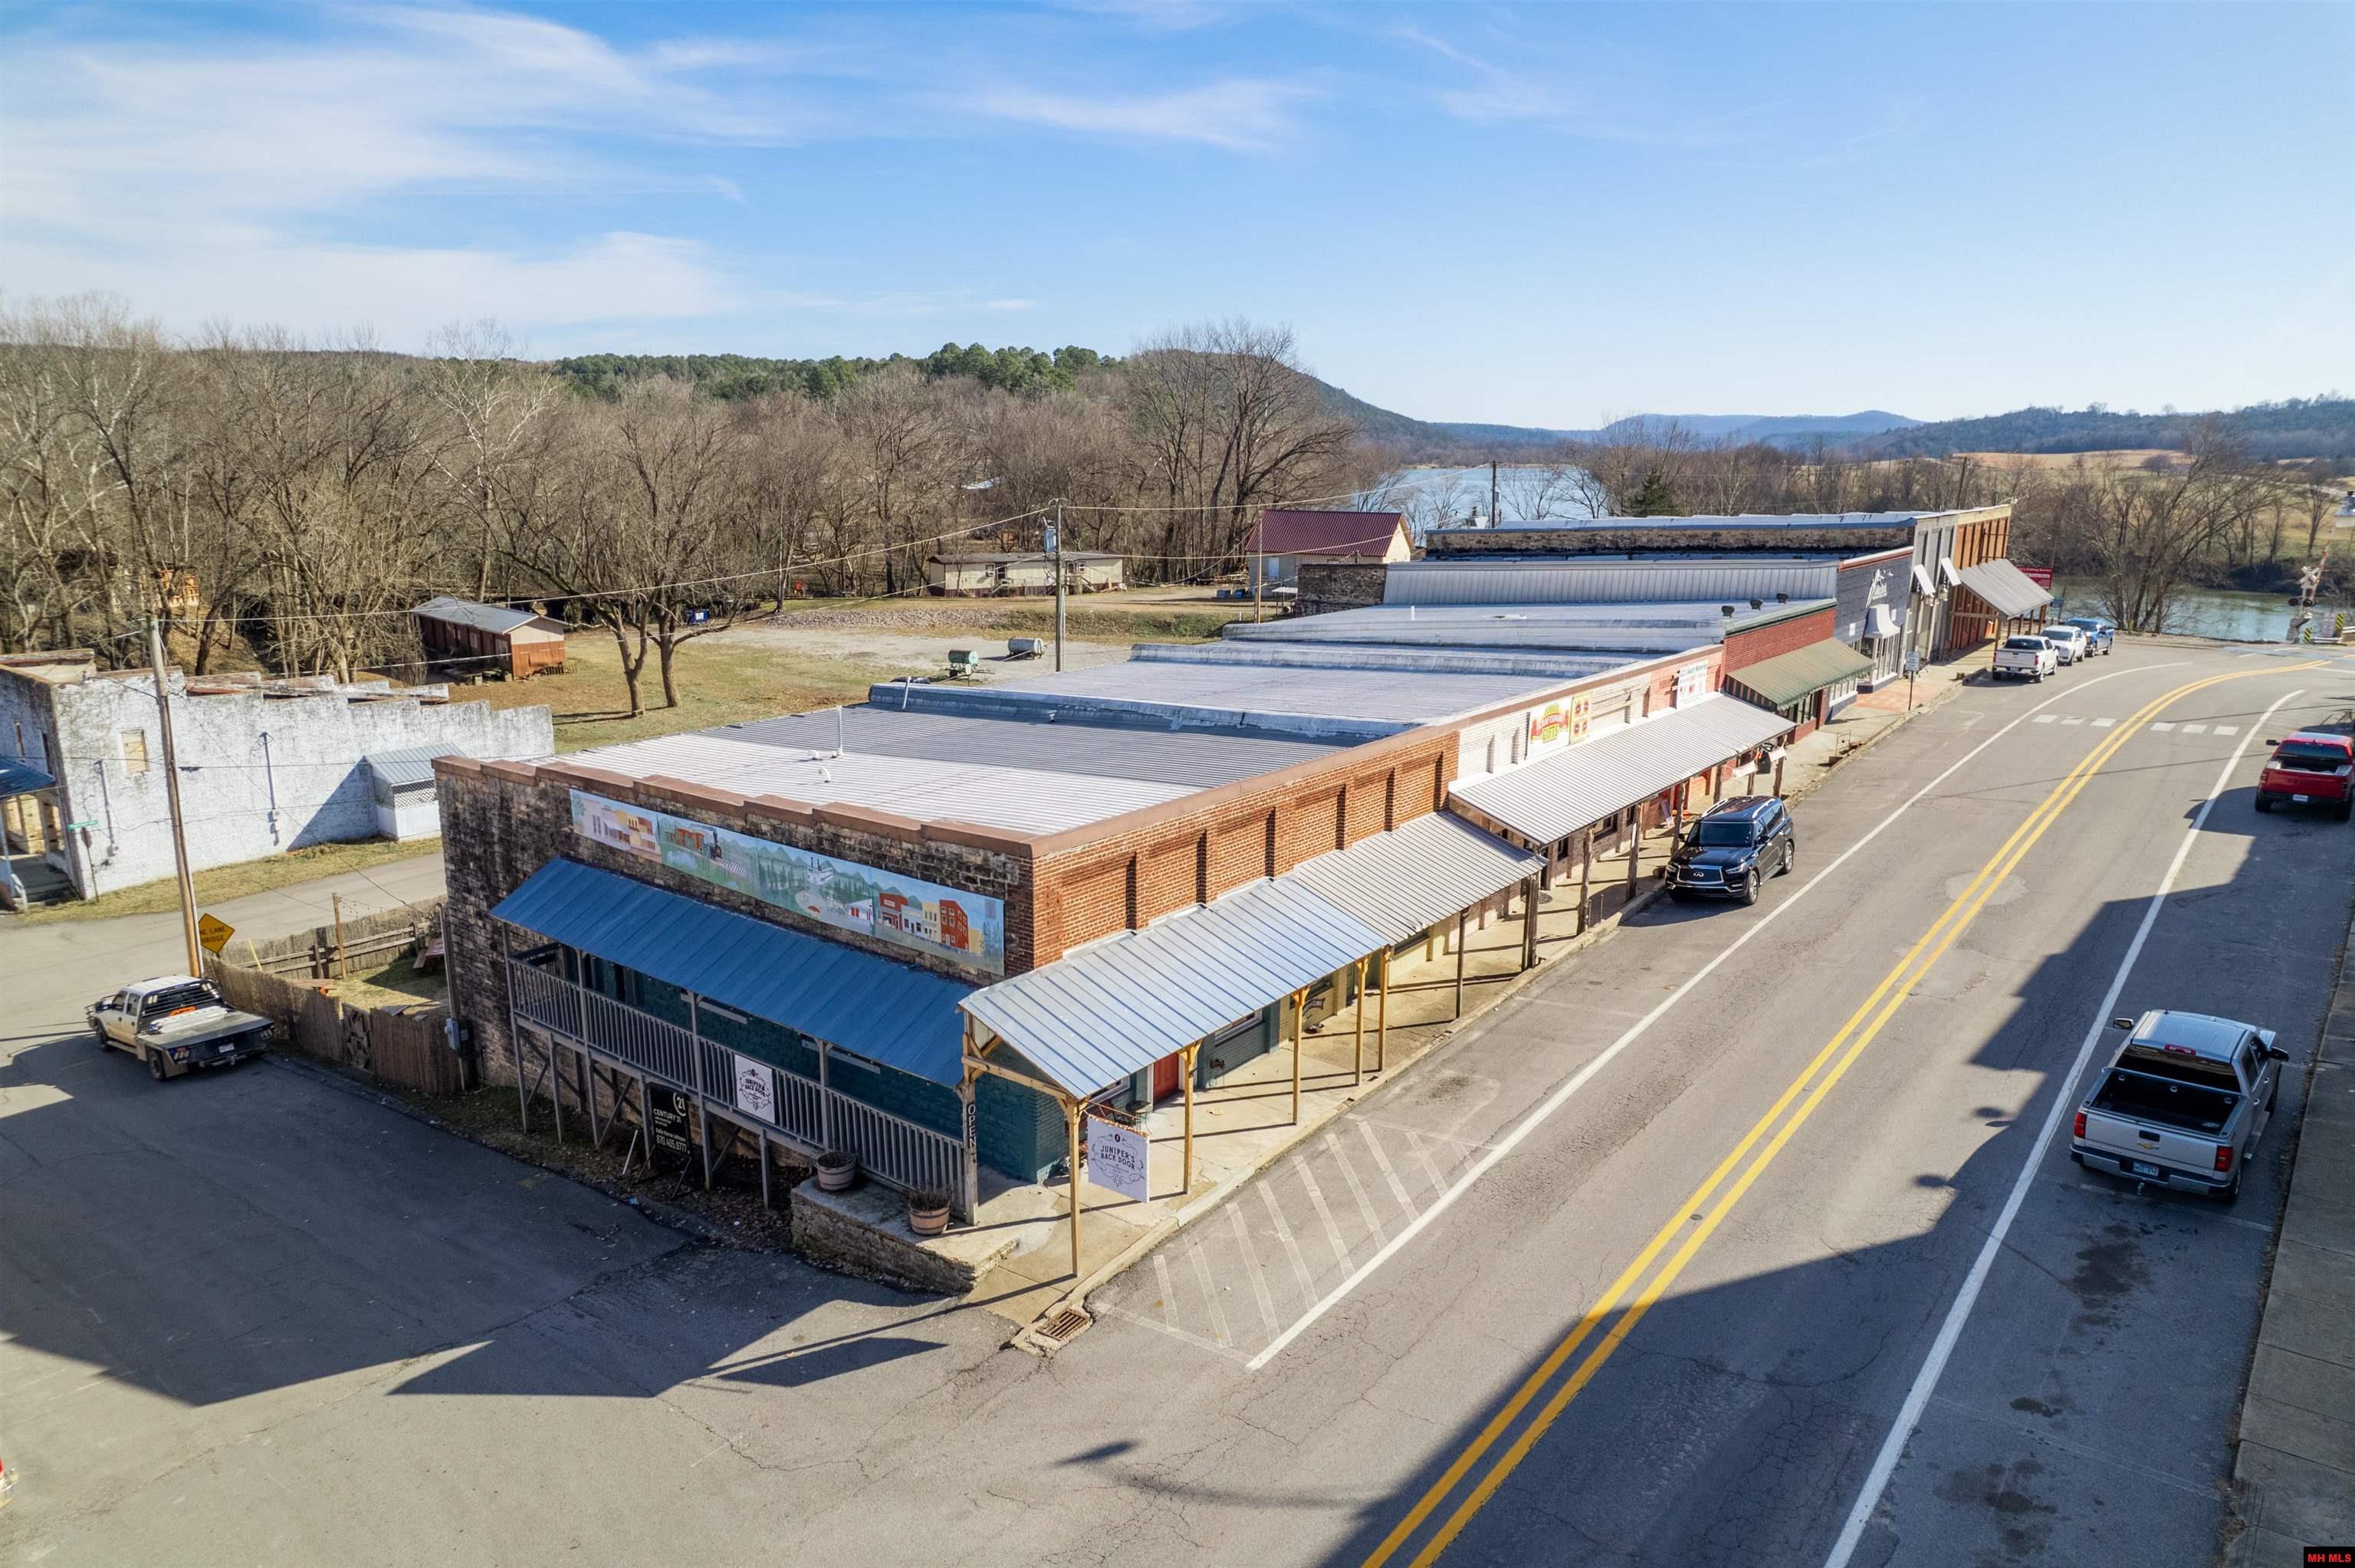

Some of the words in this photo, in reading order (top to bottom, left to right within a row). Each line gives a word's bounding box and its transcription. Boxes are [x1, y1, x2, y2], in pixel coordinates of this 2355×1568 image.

[209, 925, 225, 933] LANE
[201, 935, 225, 944] BRIDGE
[676, 1097, 685, 1110] 21
[653, 1108, 676, 1120] CENTURY
[1101, 1145, 1135, 1163] JUNIPER'S
[1101, 1152, 1116, 1161] BACK
[1118, 1156, 1135, 1170] DOOR
